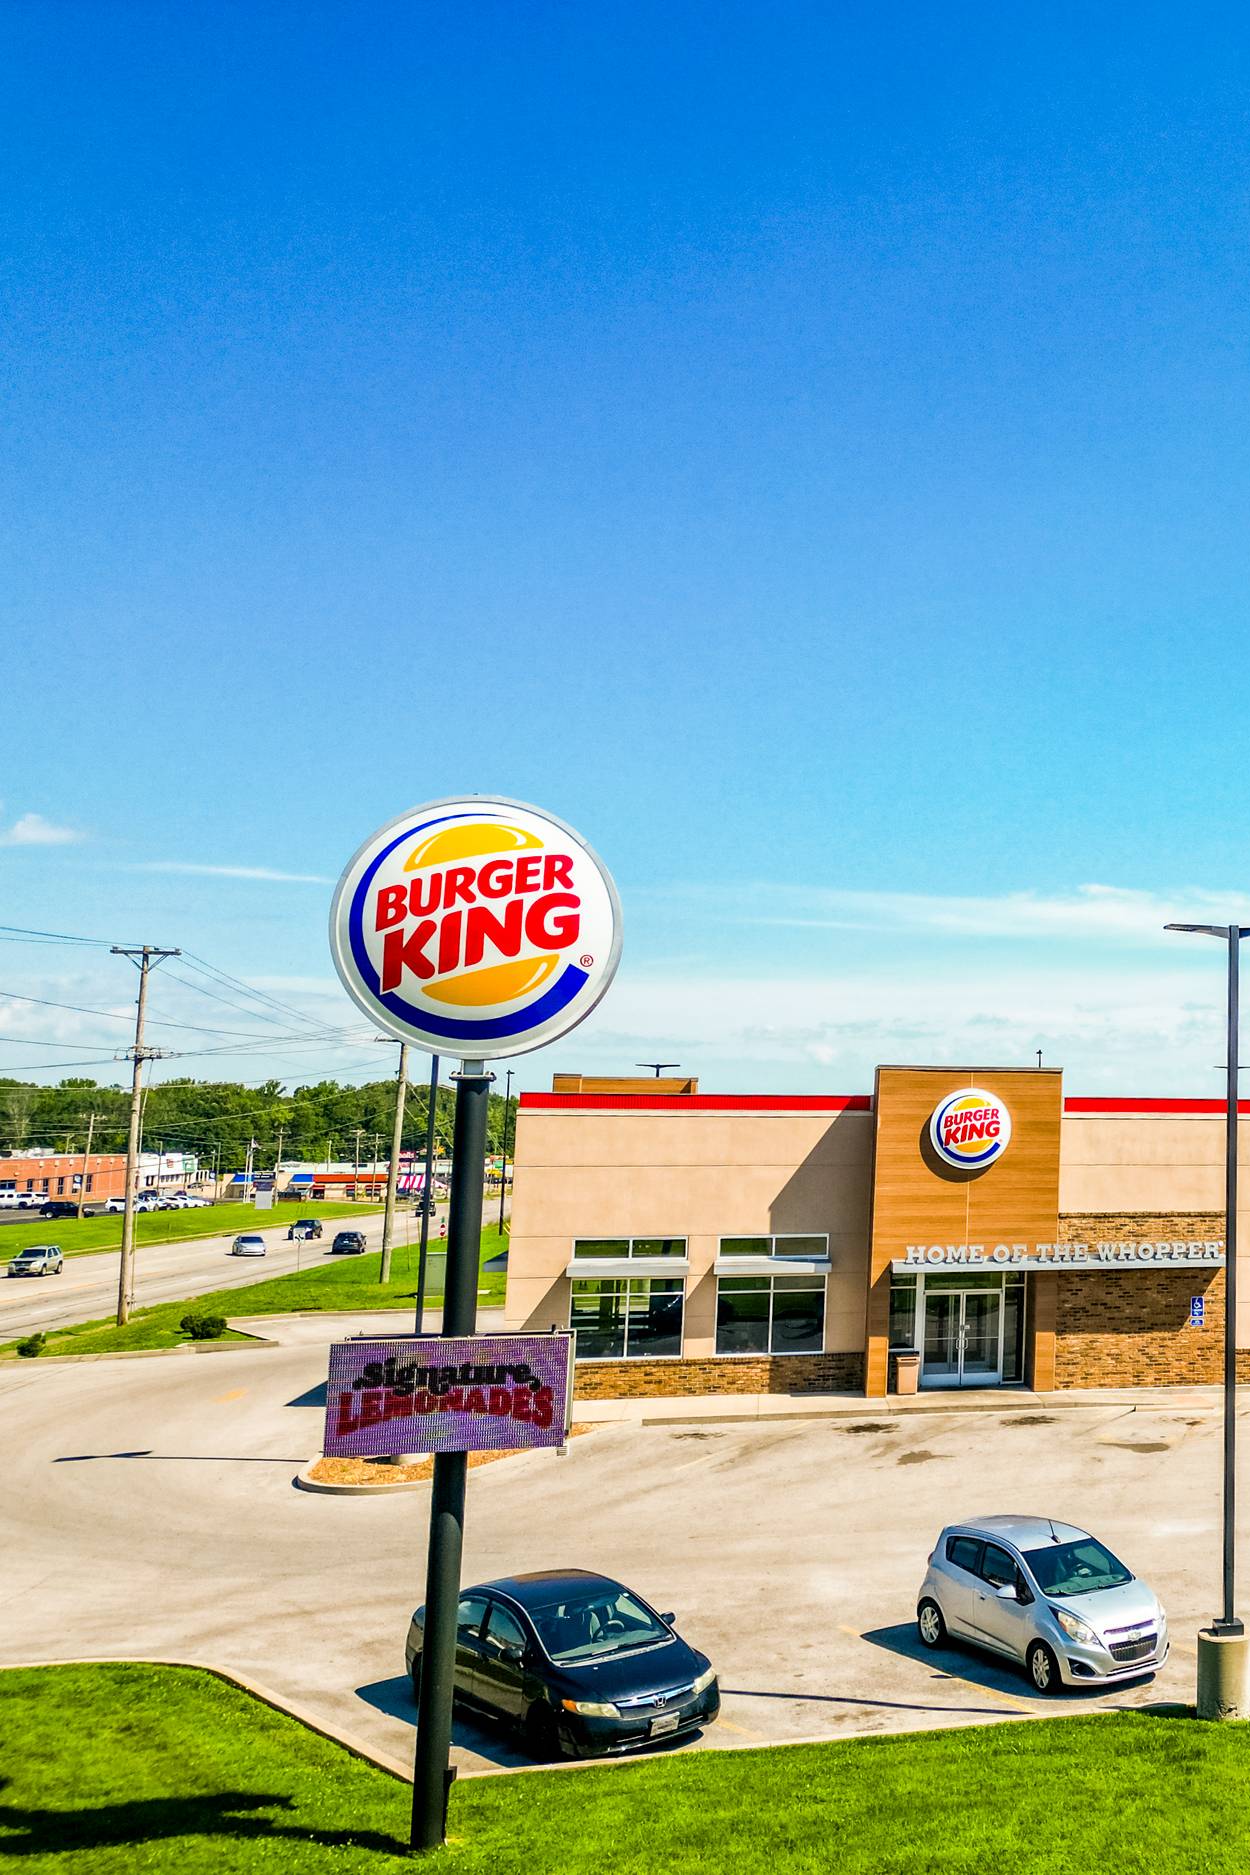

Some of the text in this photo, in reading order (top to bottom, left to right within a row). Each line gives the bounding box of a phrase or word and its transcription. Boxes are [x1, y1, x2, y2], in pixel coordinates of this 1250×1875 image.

[375, 854, 574, 932] BURGER
[382, 892, 581, 992] KING
[943, 1108, 999, 1128] BURGER
[944, 1120, 1000, 1146] KING
[905, 1241, 1219, 1264] HOME OF THE WHOPPER
[352, 1356, 540, 1396] Signature
[335, 1385, 554, 1436] LEMONADES
